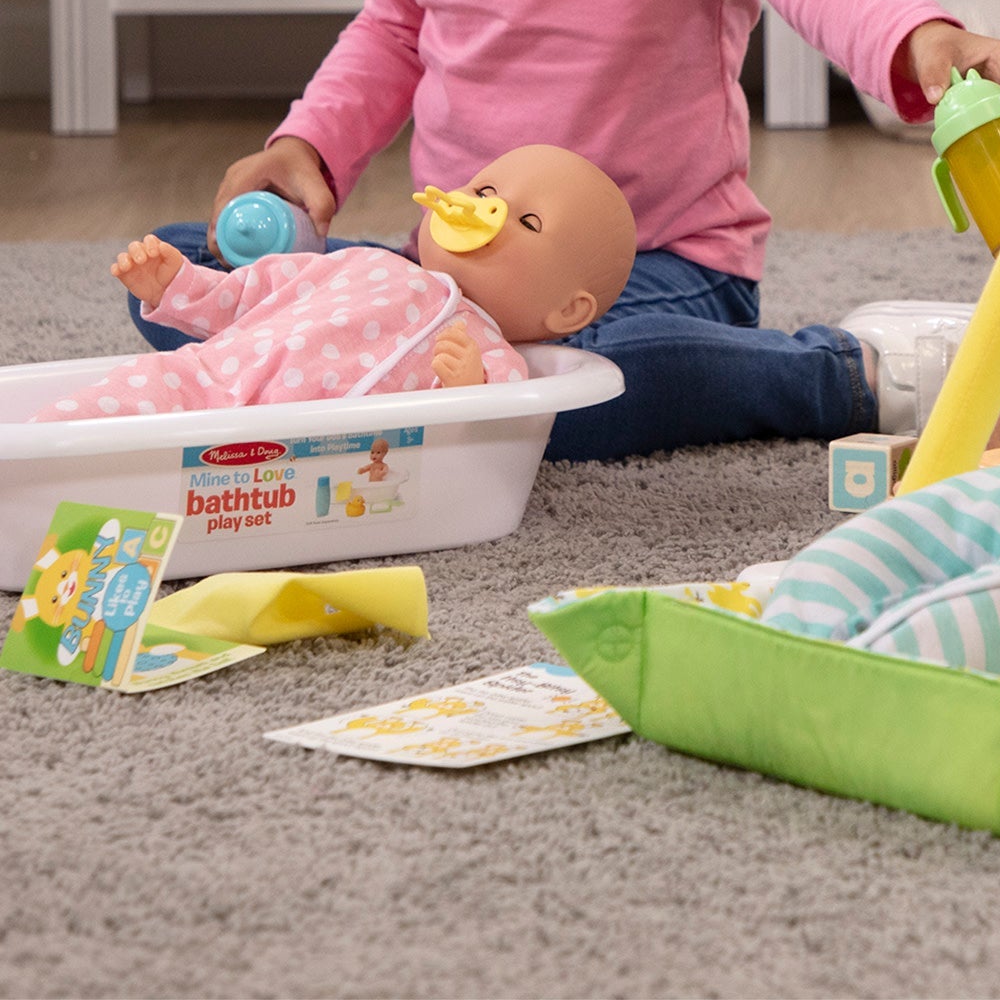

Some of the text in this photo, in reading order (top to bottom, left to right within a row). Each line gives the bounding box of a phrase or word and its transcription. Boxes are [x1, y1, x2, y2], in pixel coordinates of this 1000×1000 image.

[207, 448, 247, 462] Melissa
[257, 446, 281, 459] Doug
[190, 466, 295, 488] Mine to Love
[186, 483, 296, 516] bathtub
[207, 511, 272, 534] play set
[59, 534, 115, 654] BUNNY
[120, 588, 132, 607] to
[124, 579, 148, 617] Play
